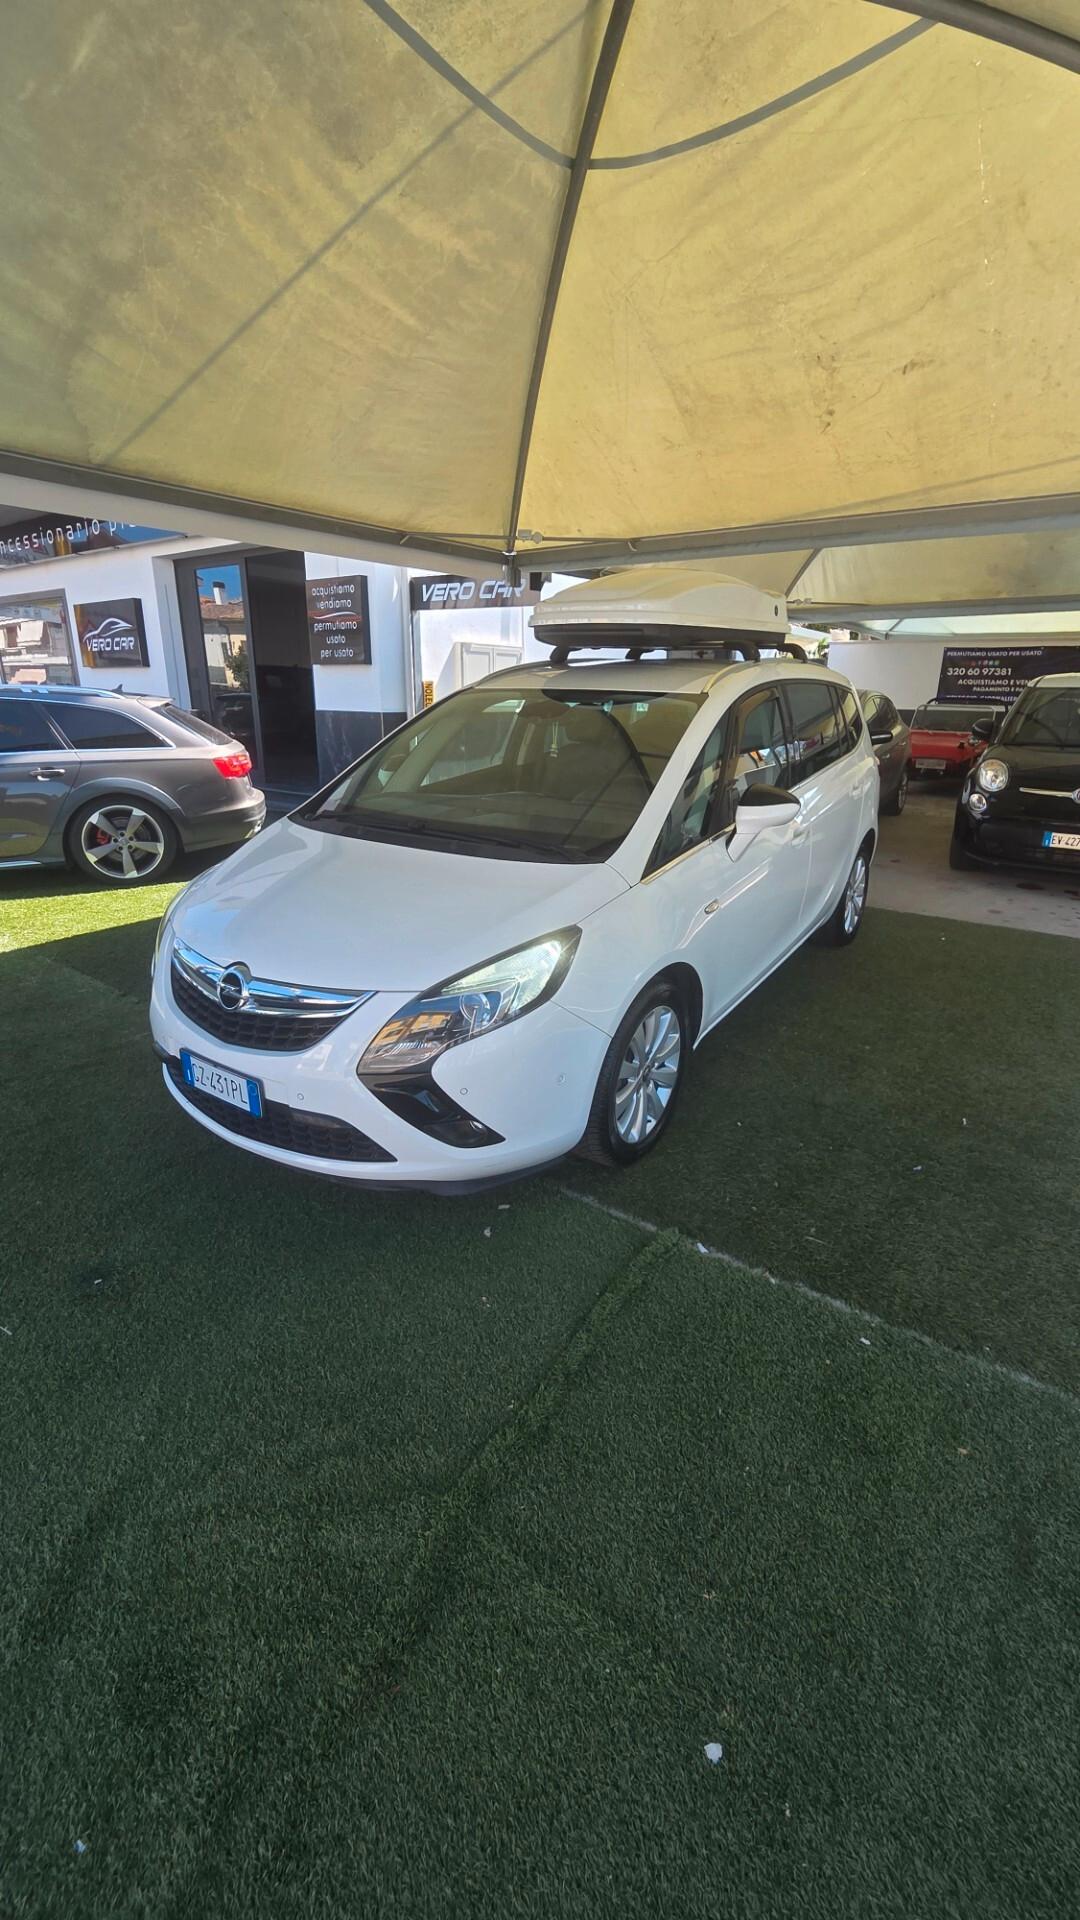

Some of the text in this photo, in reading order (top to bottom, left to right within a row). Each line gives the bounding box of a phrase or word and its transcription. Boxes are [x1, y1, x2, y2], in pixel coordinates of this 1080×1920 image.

[311, 584, 355, 598] acquistiamo
[422, 581, 476, 602] VERO
[316, 597, 352, 609] vendiamo
[313, 620, 358, 633] permutiamo
[86, 636, 135, 652] VERO CAR
[326, 634, 346, 644] usato
[320, 648, 354, 660] per usato
[946, 667, 1012, 676] 320 60 97381
